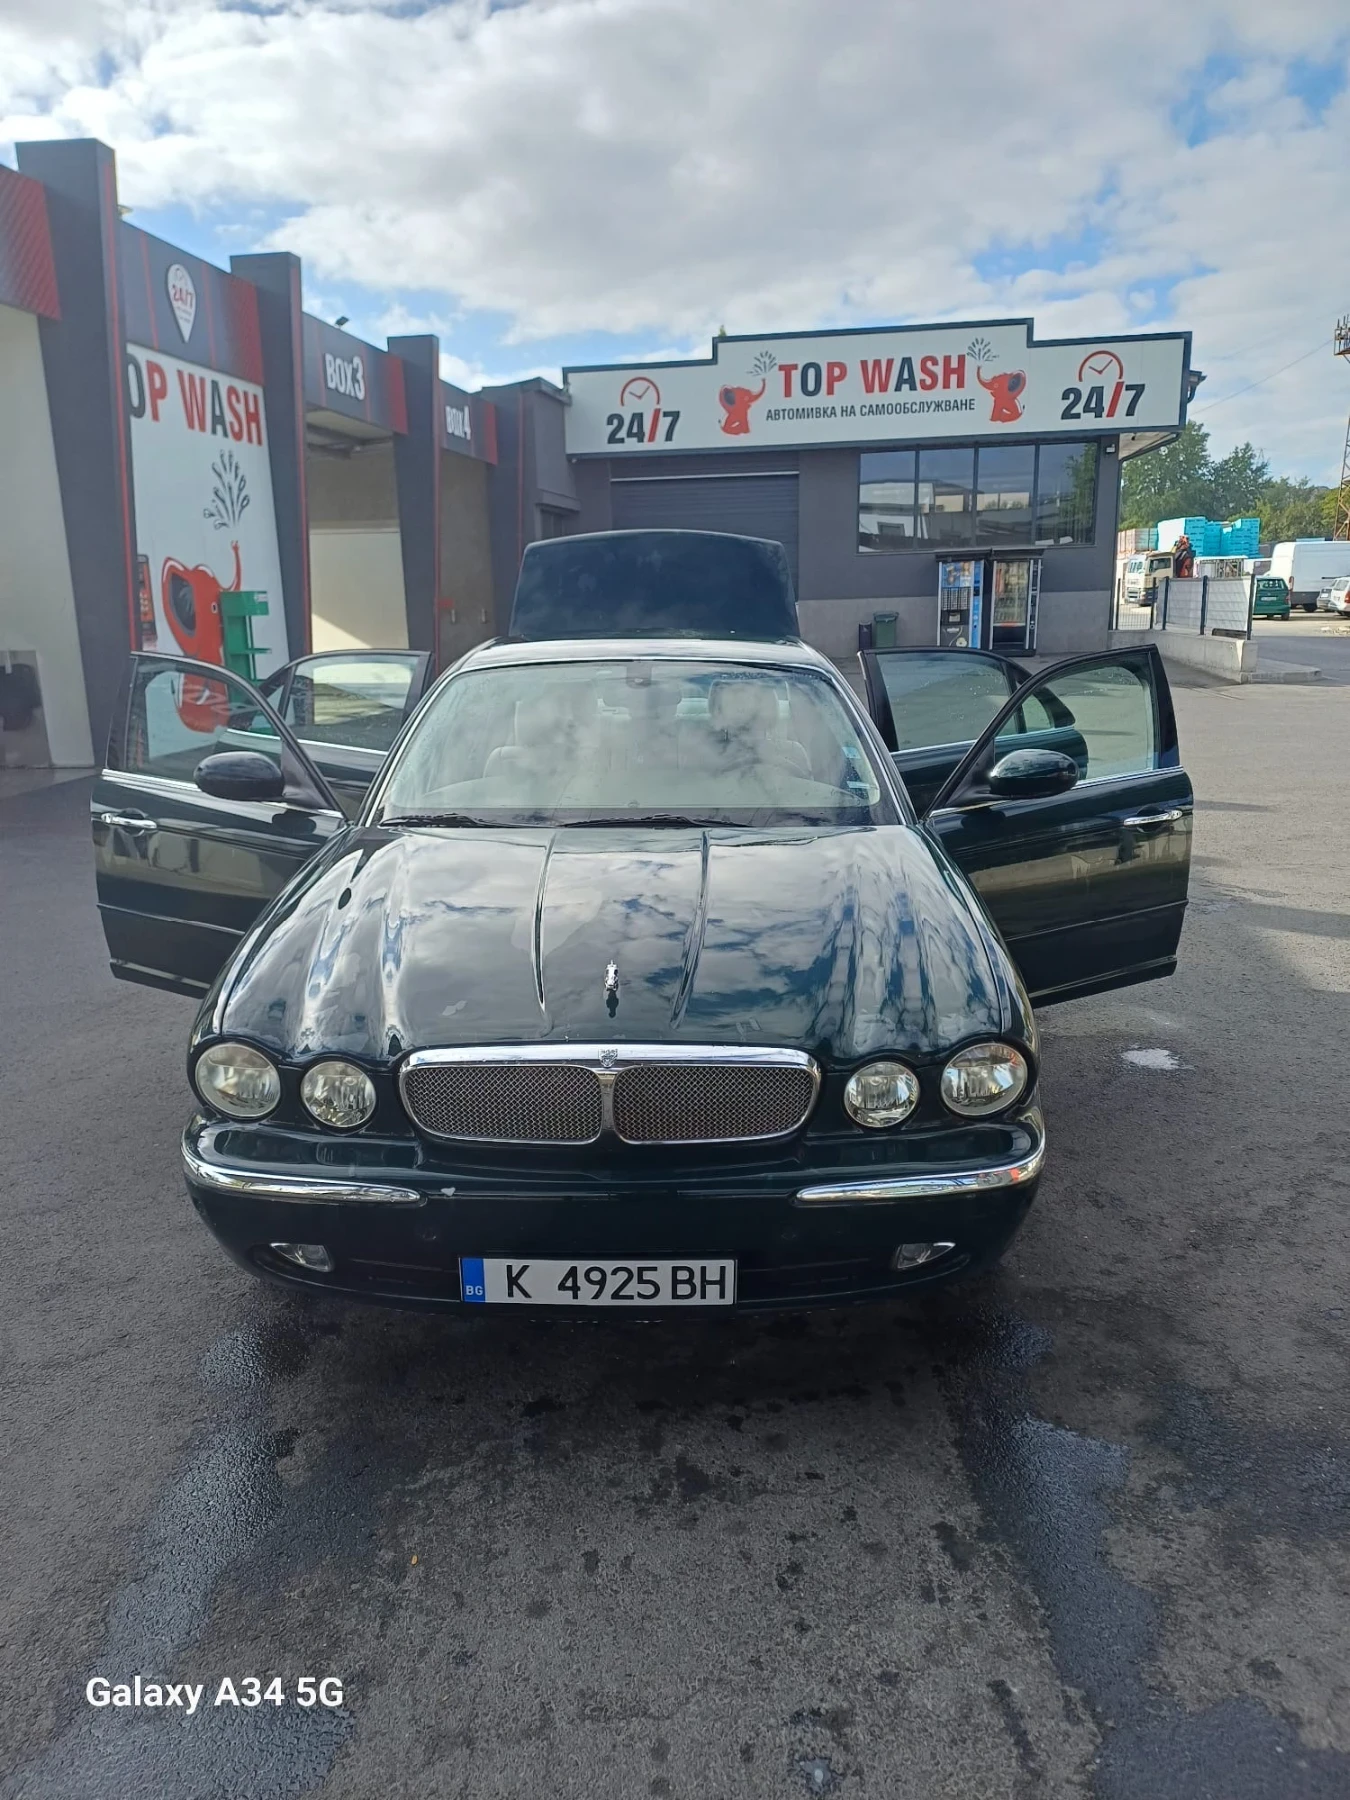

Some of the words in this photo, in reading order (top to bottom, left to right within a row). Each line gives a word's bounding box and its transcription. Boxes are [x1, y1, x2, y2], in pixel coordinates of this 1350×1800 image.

[778, 361, 848, 398] TOP
[859, 354, 966, 394] WASH
[127, 353, 167, 422] OP
[176, 368, 263, 447] WASH
[766, 406, 837, 422] АВТОМИВКА
[840, 404, 857, 418] НА
[859, 398, 976, 417] САМООБСЛУЖВАНЕ
[1060, 381, 1146, 420] 24/7
[606, 408, 681, 445] 24/7
[465, 1285, 484, 1296] BG
[505, 1264, 532, 1299] K
[557, 1265, 661, 1300] 4925
[670, 1265, 726, 1300] BH
